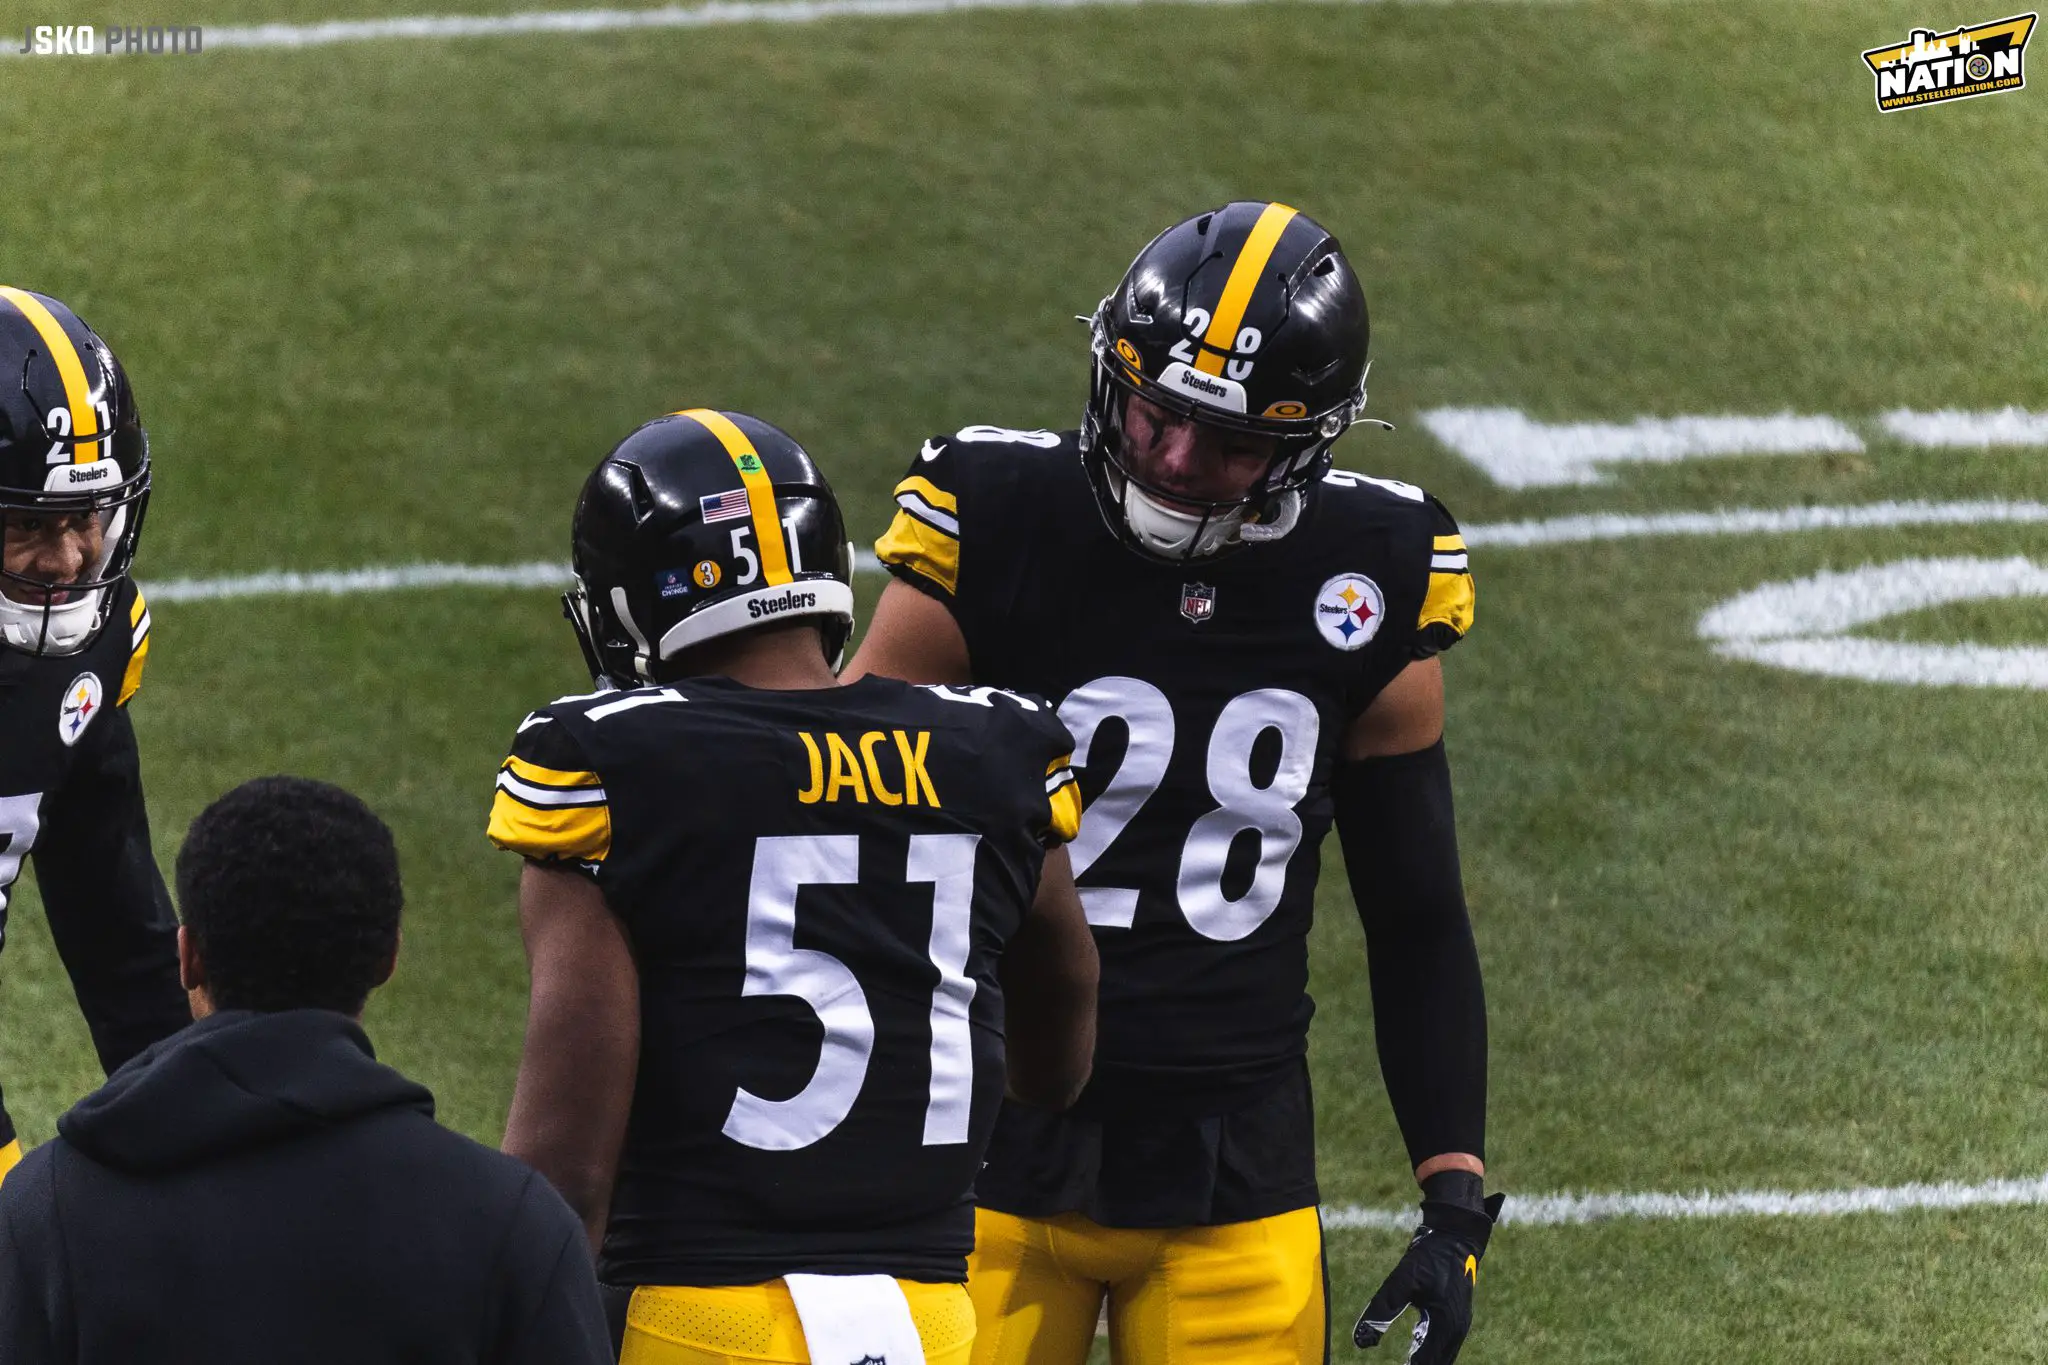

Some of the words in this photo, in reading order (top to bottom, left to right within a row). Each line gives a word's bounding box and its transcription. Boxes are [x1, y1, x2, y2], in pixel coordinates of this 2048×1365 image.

[1182, 370, 1227, 398] Steelers
[69, 467, 108, 483] Steelers
[701, 561, 715, 586] 3
[747, 591, 816, 618] Steelers
[1320, 603, 1348, 615] Steelers
[798, 730, 941, 808] JACK
[1056, 676, 1319, 941] 28
[721, 834, 983, 1151] 51
